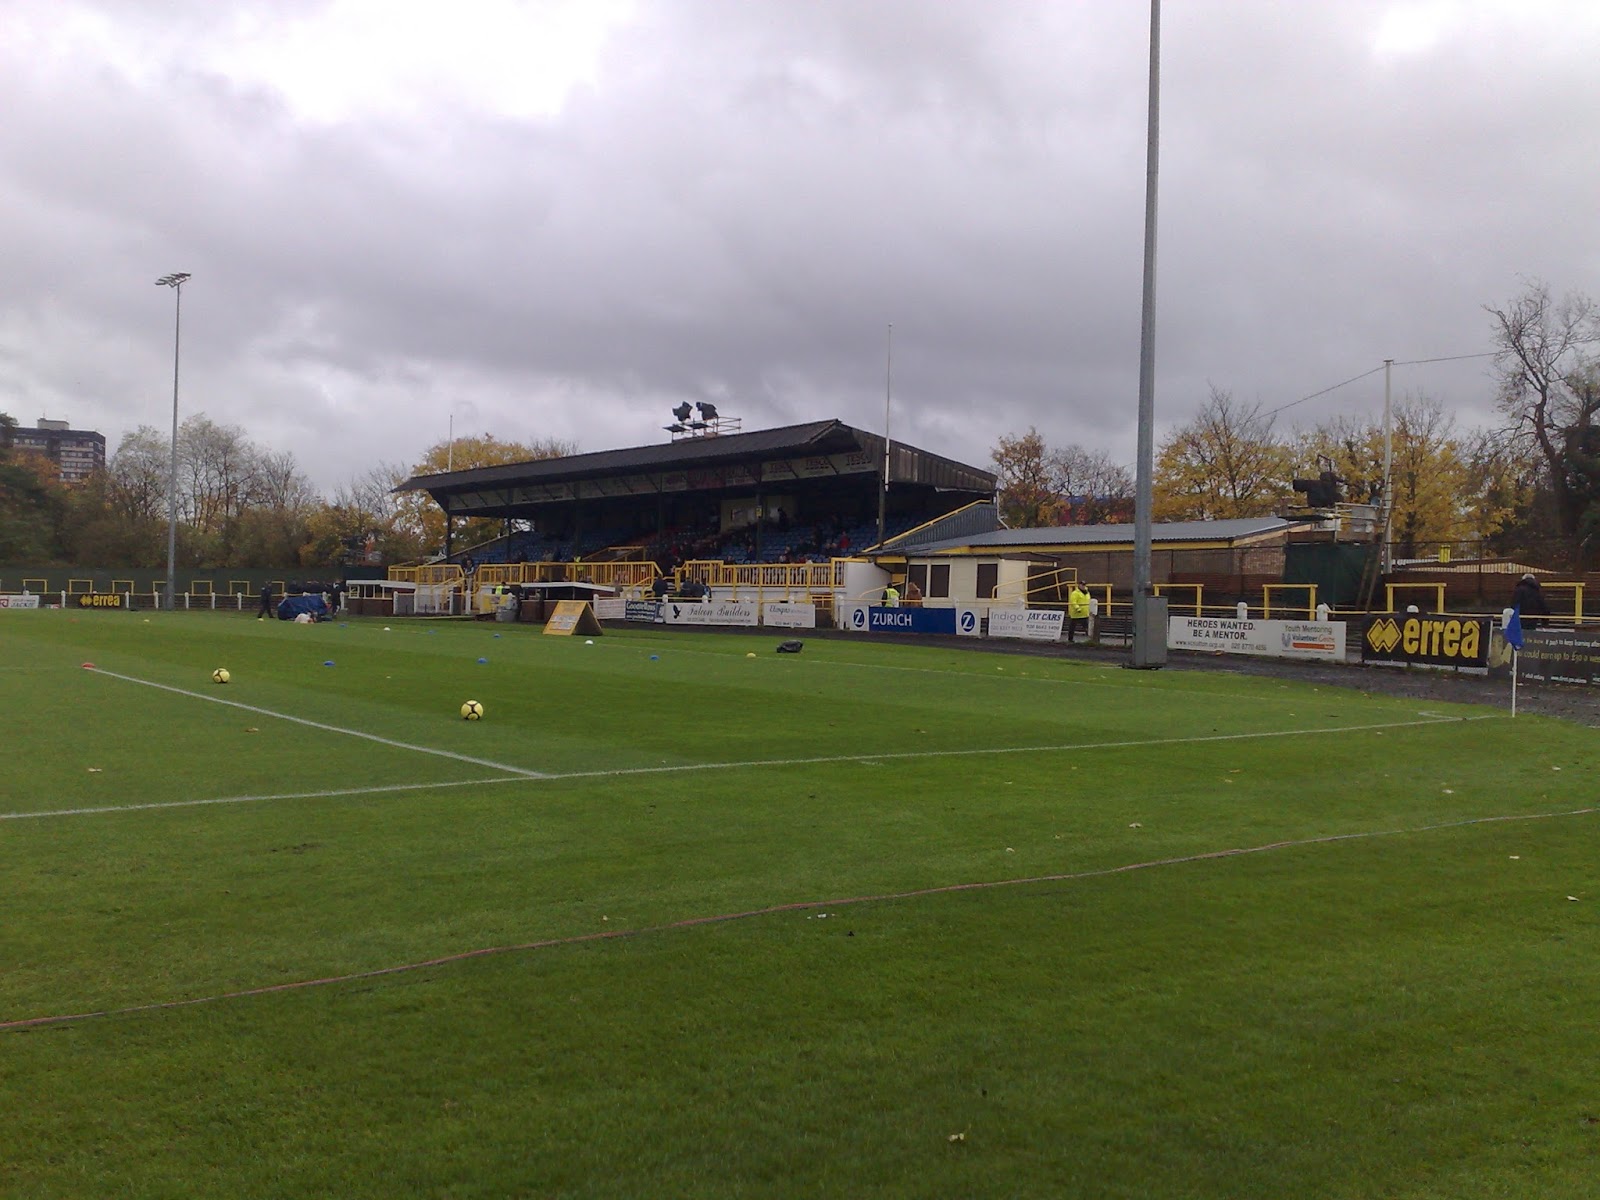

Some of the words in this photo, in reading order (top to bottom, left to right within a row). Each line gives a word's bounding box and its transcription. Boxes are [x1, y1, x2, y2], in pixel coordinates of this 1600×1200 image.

[716, 604, 751, 617] Builders
[872, 612, 913, 627] ZURICH
[991, 611, 1024, 623] Indigo
[1026, 612, 1041, 622] JAY
[1041, 613, 1063, 622] CARS
[1187, 619, 1218, 629] HEROES
[1220, 620, 1256, 631] WANTED.
[1193, 629, 1203, 638] BE
[1204, 630, 1210, 638] A
[1212, 630, 1248, 640] MENTOR.
